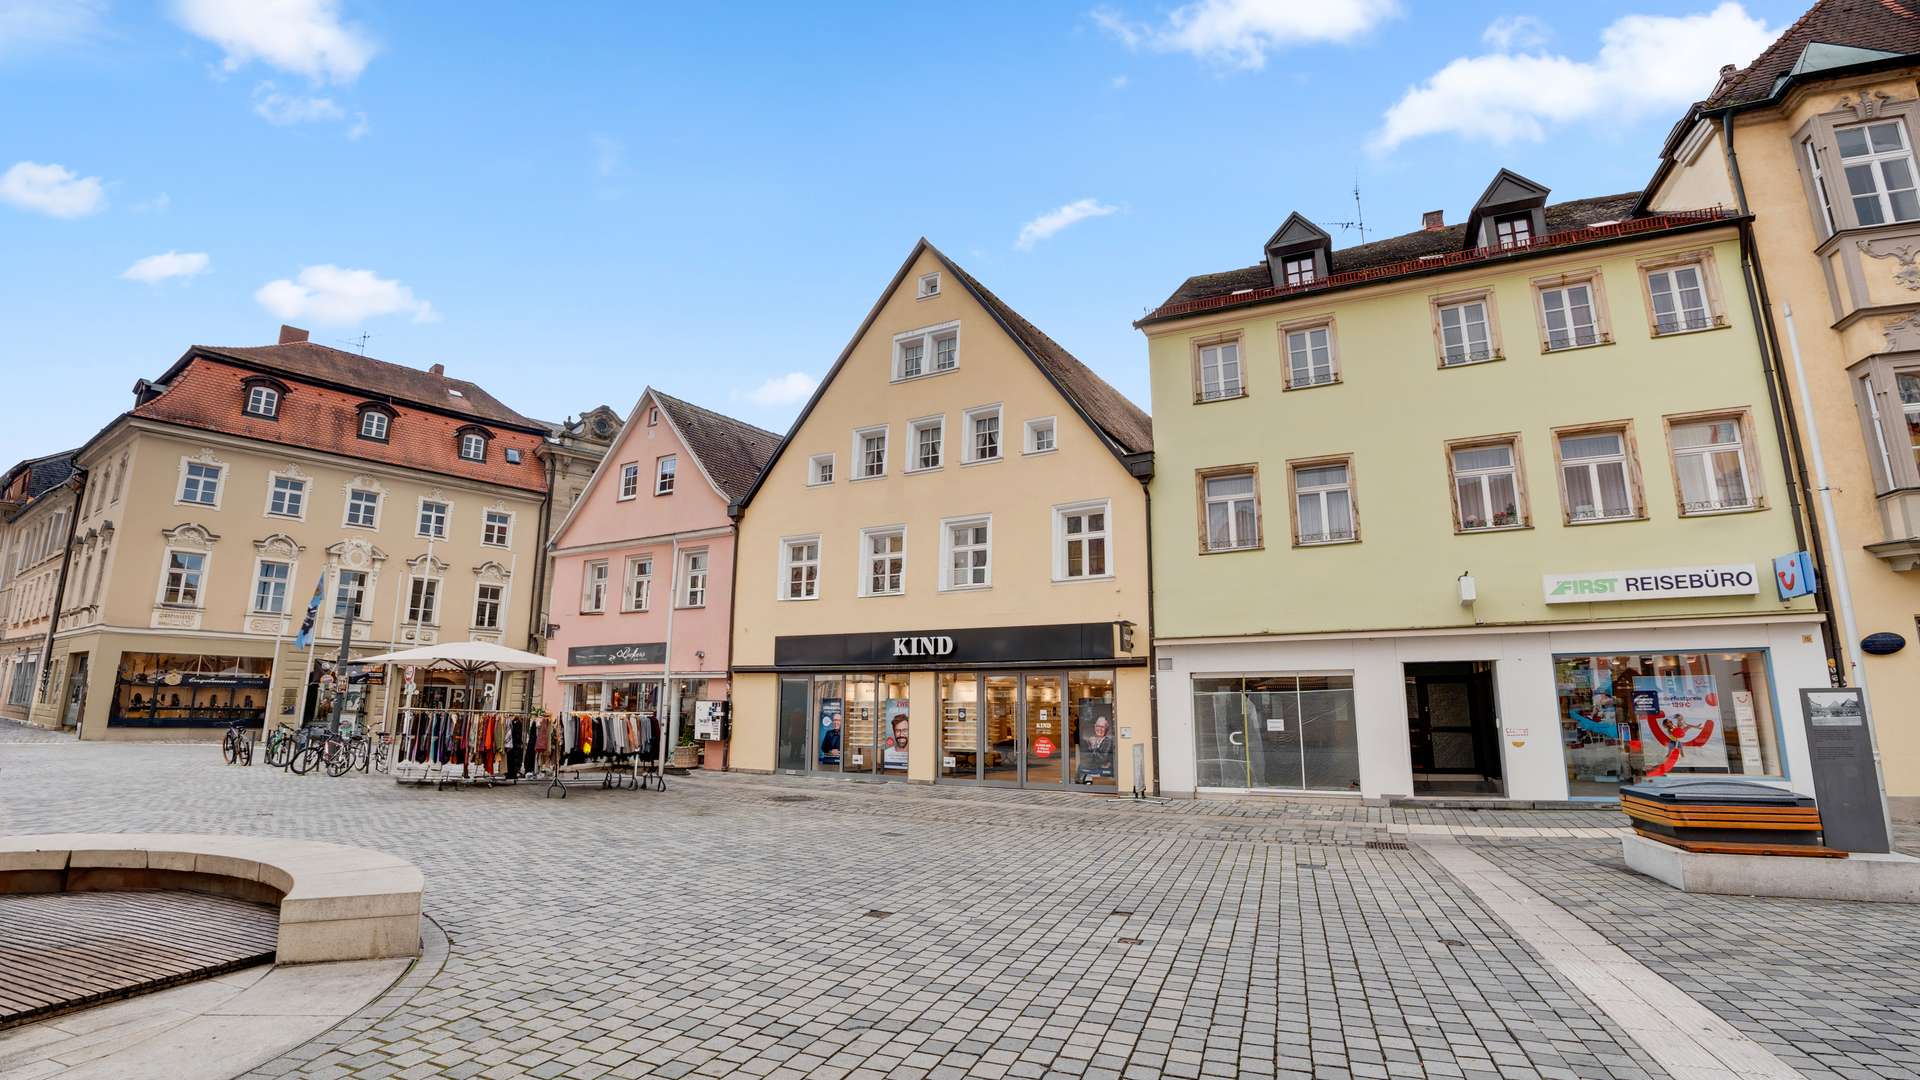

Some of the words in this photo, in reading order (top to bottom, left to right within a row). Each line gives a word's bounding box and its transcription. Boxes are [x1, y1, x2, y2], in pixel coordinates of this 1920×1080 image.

[1550, 578, 1617, 595] FIRST
[1625, 569, 1753, 592] REISEBÜRO
[893, 636, 953, 656] KIND
